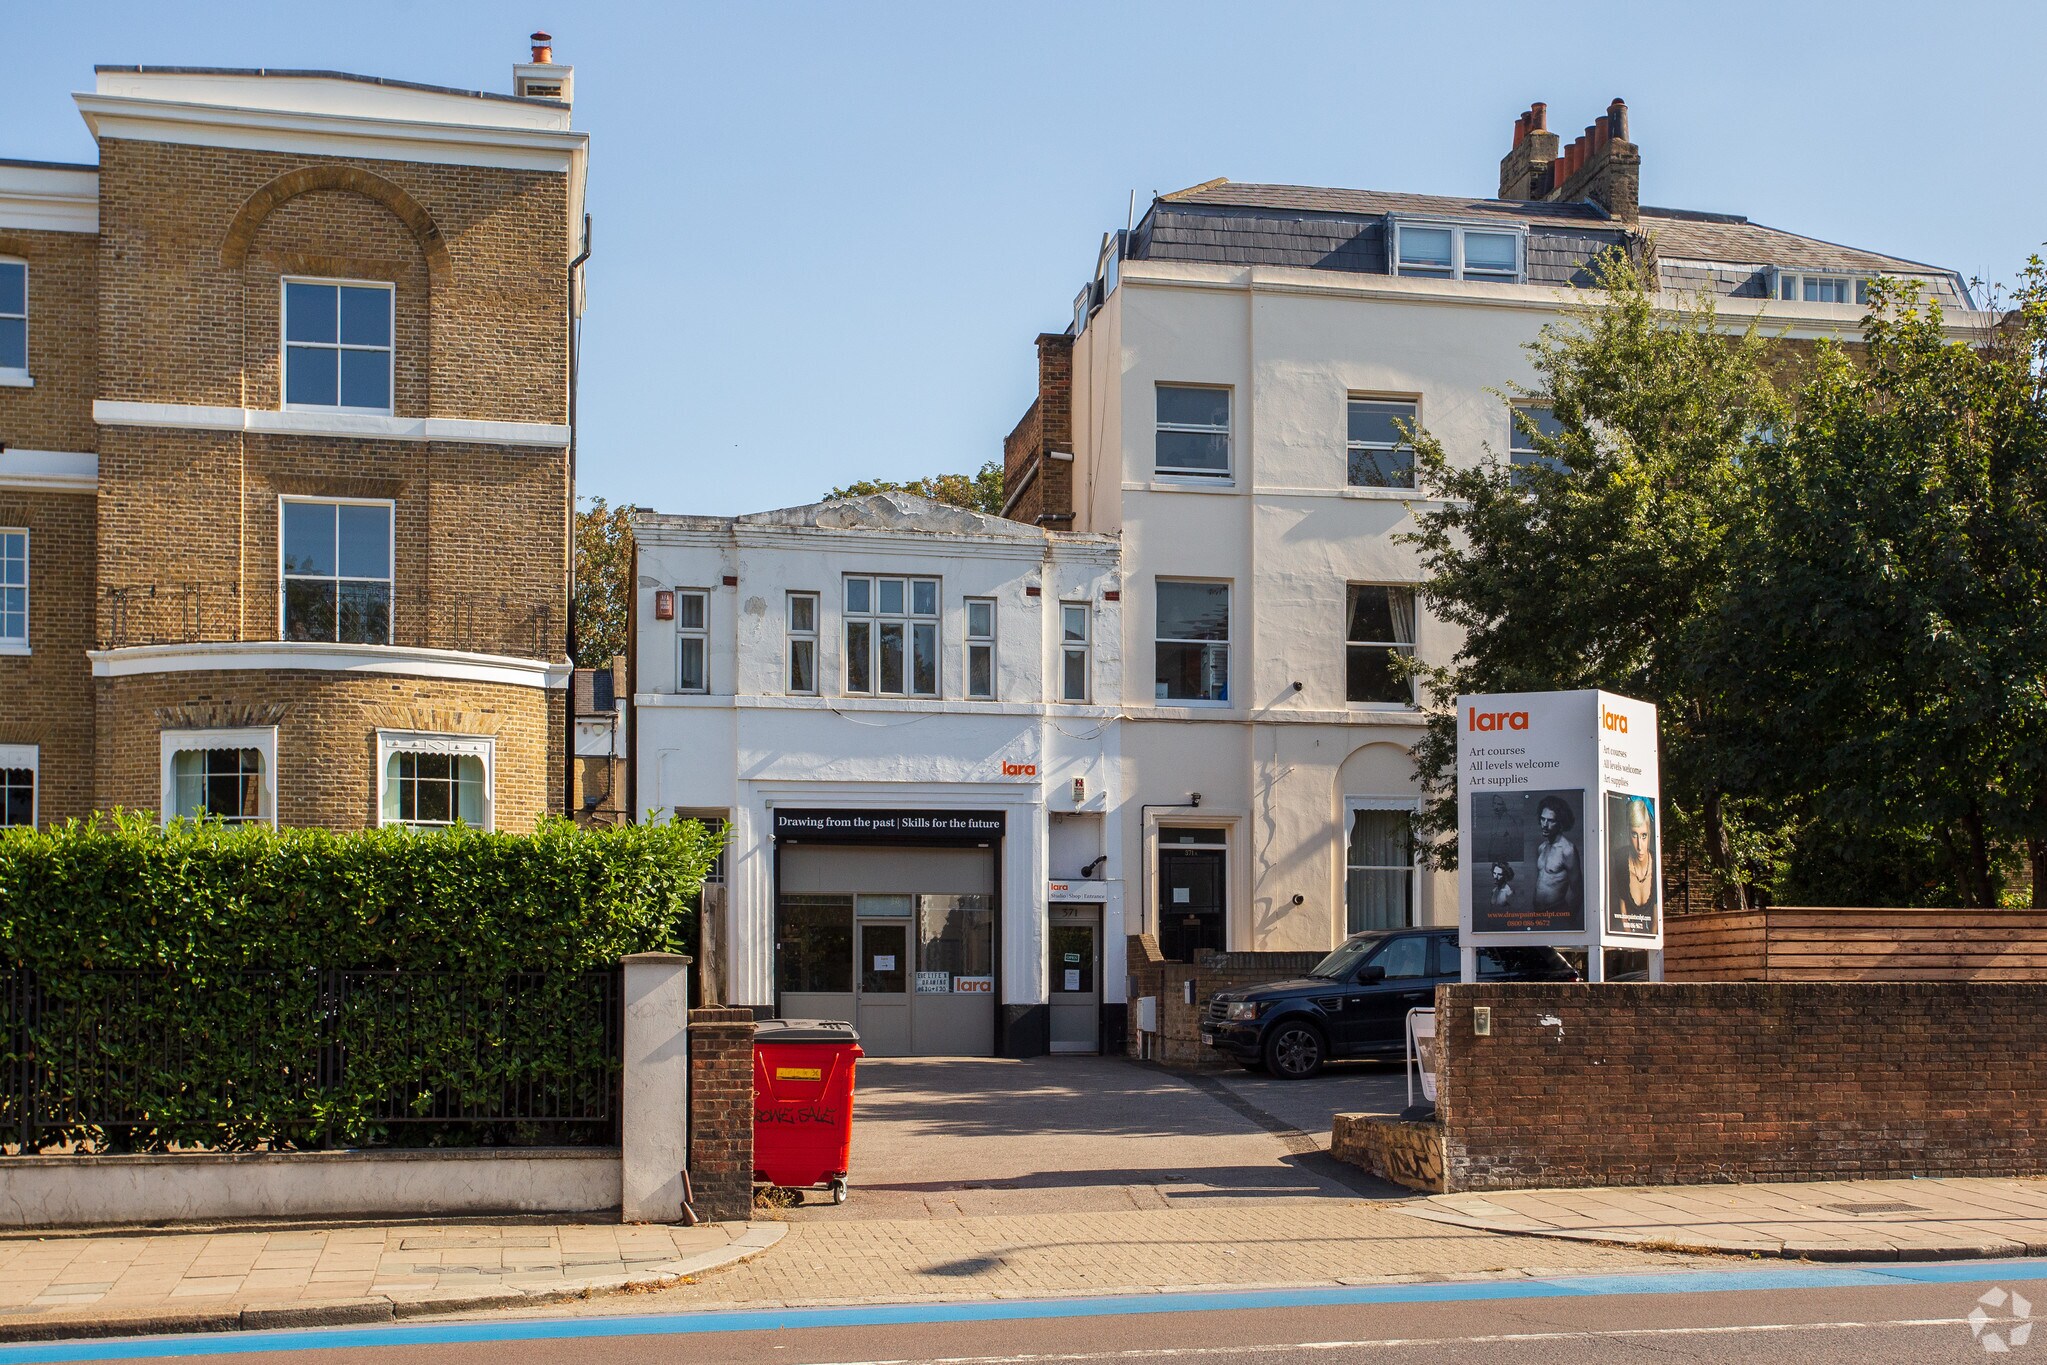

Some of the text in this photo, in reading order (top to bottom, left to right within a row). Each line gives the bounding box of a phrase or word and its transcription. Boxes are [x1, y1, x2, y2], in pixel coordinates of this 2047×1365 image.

[1469, 707, 1529, 732] lara
[1602, 704, 1628, 734] lara
[1469, 747, 1526, 757] Art courses
[1611, 748, 1627, 758] courses
[1002, 760, 1036, 776] lara
[1469, 759, 1560, 771] All levels welcome
[1610, 760, 1622, 772] levels
[1622, 764, 1642, 775] welcome
[1469, 774, 1529, 787] Art supplies
[1611, 777, 1629, 788] supplies
[778, 816, 1000, 830] Drawing from the past Skills for the future
[1051, 883, 1069, 891] lara
[1062, 908, 1078, 917] 371
[1487, 910, 1571, 920] www.drawpaintsculpt.com
[1507, 920, 1522, 928] 0800
[1535, 919, 1550, 927] 9672
[956, 977, 992, 992] lara
